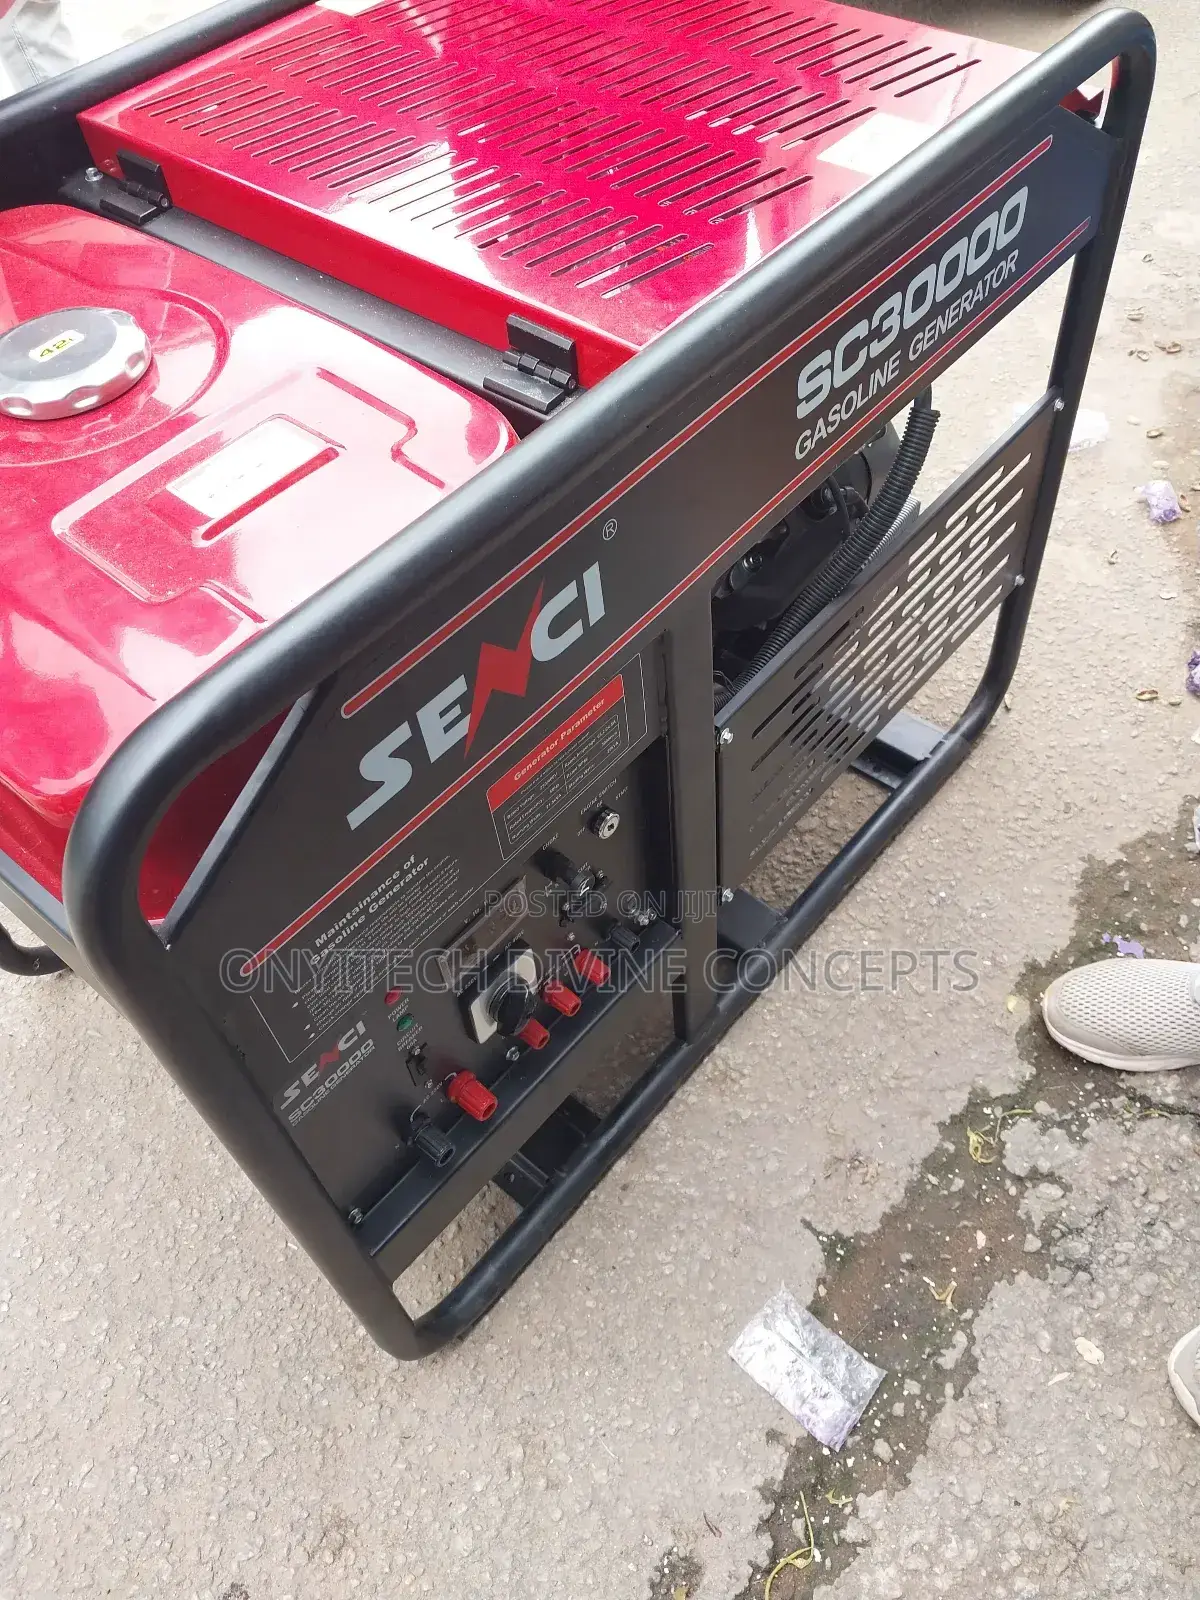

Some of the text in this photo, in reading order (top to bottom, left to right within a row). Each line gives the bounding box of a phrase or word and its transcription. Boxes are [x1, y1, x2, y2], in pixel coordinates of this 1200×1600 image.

[797, 186, 1029, 420] SC30000
[794, 249, 1019, 460] GASOLINE GENERATOR
[346, 561, 605, 831] SENCI
[514, 739, 558, 781] Generator
[560, 698, 605, 740] Parameter
[310, 857, 429, 965] Gasoline Generator
[315, 855, 415, 947] Maintainance of
[387, 997, 409, 1020] POWER
[392, 1004, 409, 1023] LAMP
[396, 1023, 419, 1046] CIRCUIT
[397, 1026, 423, 1052] BREAKER
[280, 1020, 366, 1110] SENCI
[288, 1038, 374, 1123] SC30000
[291, 1045, 376, 1127] GASOLINE GENERATOR
